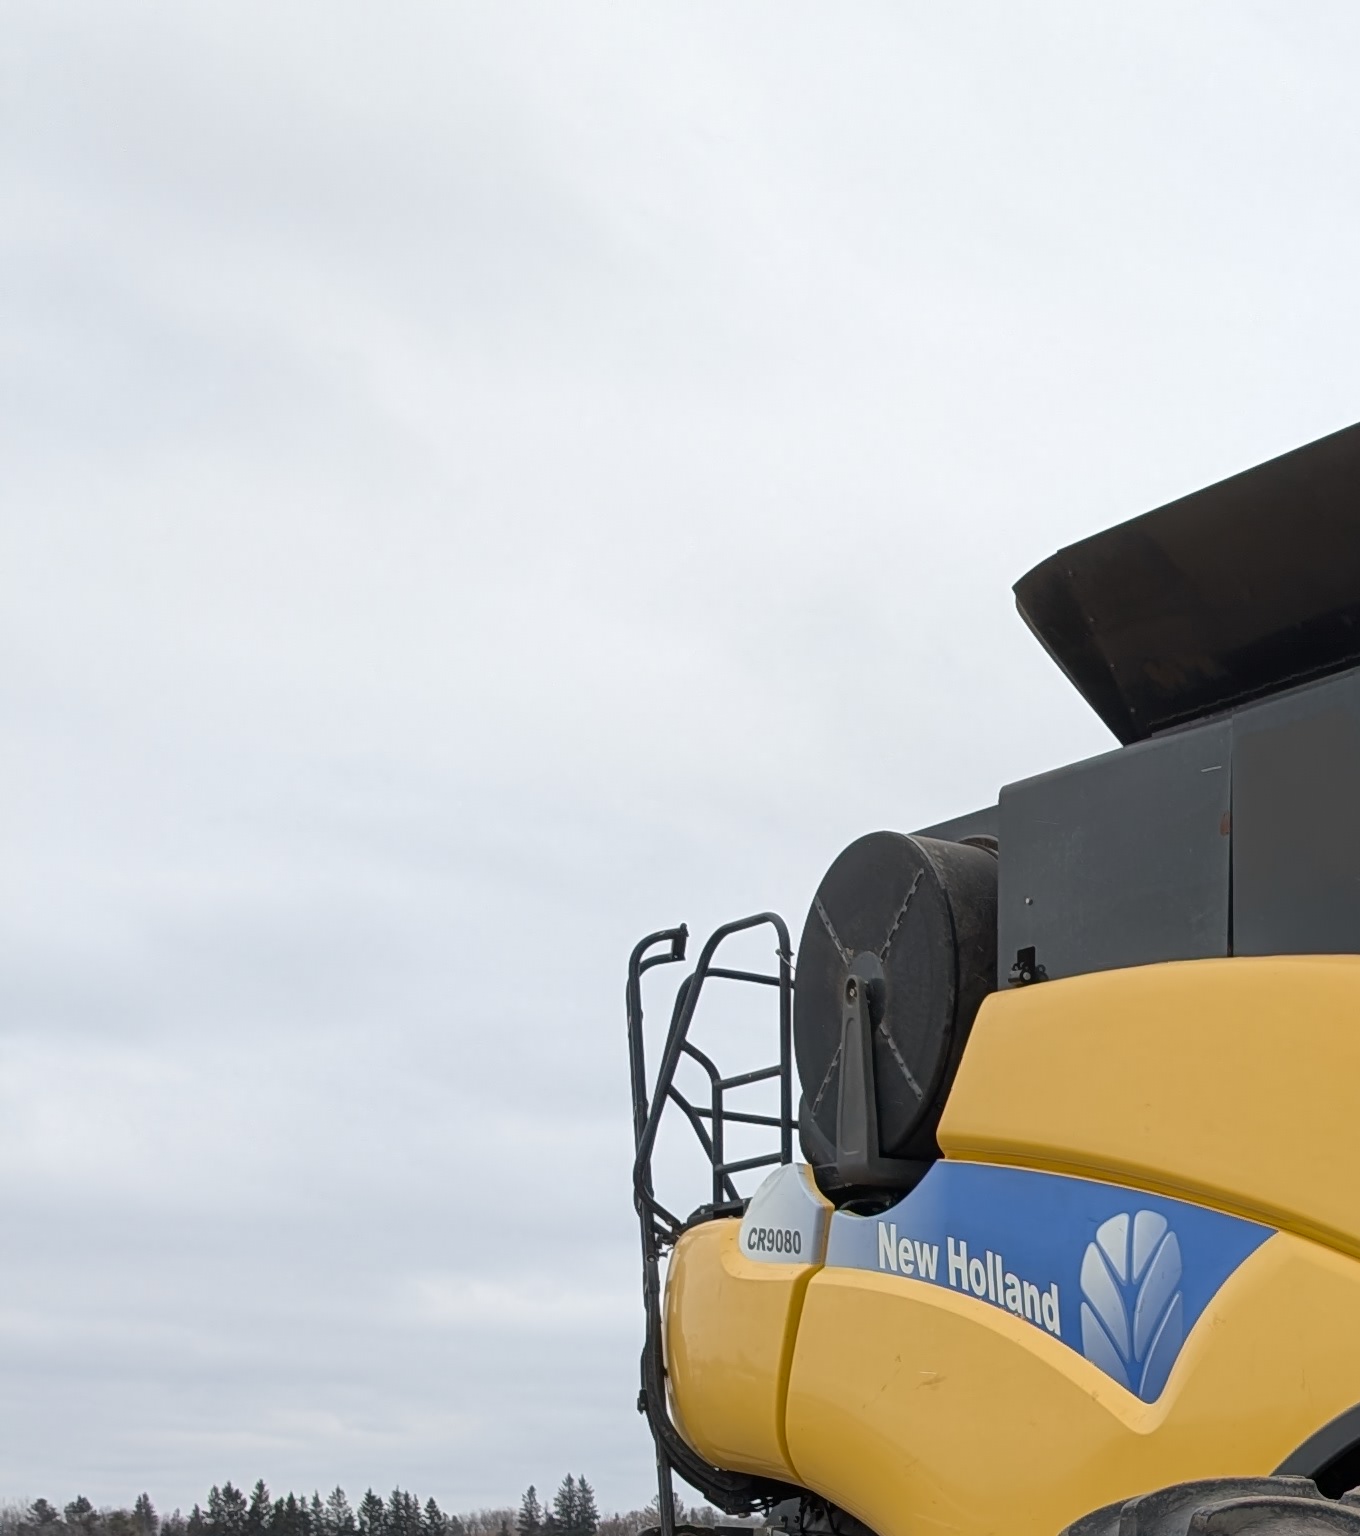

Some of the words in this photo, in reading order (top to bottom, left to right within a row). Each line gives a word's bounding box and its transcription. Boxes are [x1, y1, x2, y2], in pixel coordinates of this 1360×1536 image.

[747, 1227, 802, 1255] CR9080
[877, 1221, 939, 1281] New
[947, 1236, 1061, 1337] Holland
